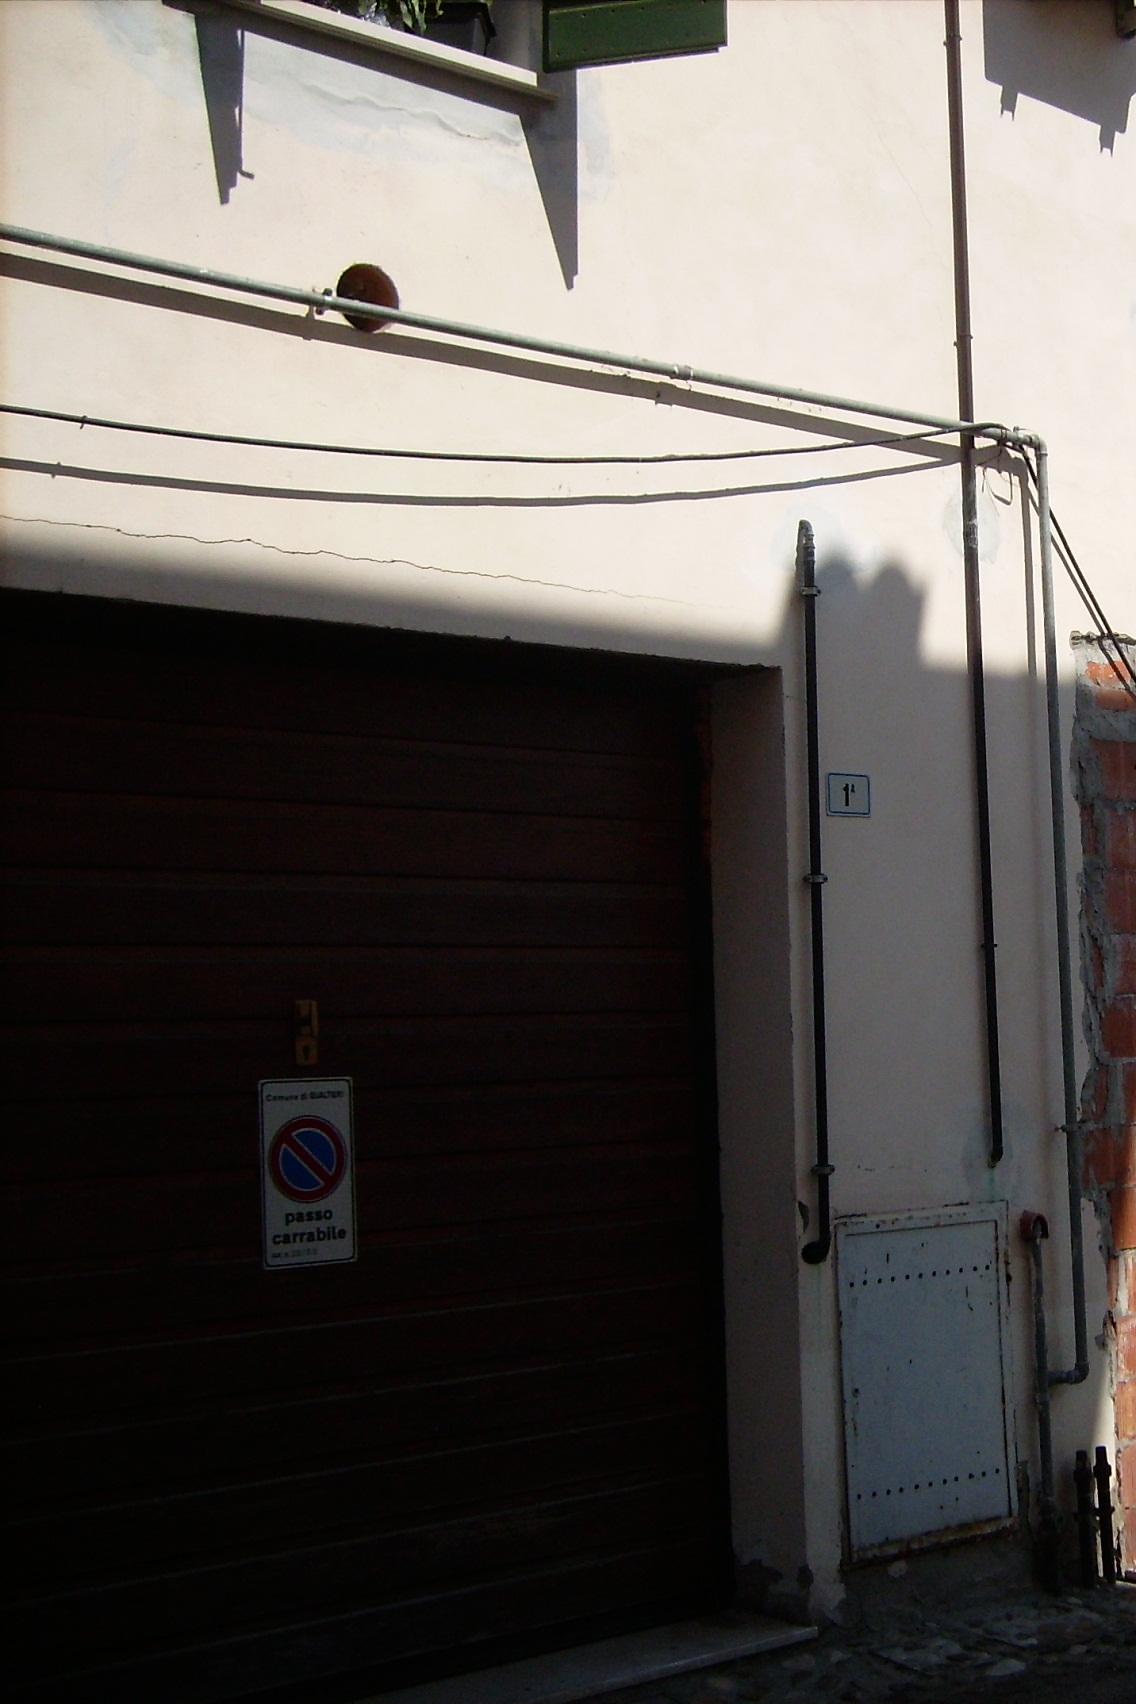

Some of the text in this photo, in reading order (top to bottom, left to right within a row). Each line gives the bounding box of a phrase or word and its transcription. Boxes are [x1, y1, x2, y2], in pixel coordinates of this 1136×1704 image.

[266, 1094, 298, 1102] Comune
[285, 1209, 333, 1226] passo
[272, 1226, 347, 1245] carrabile
